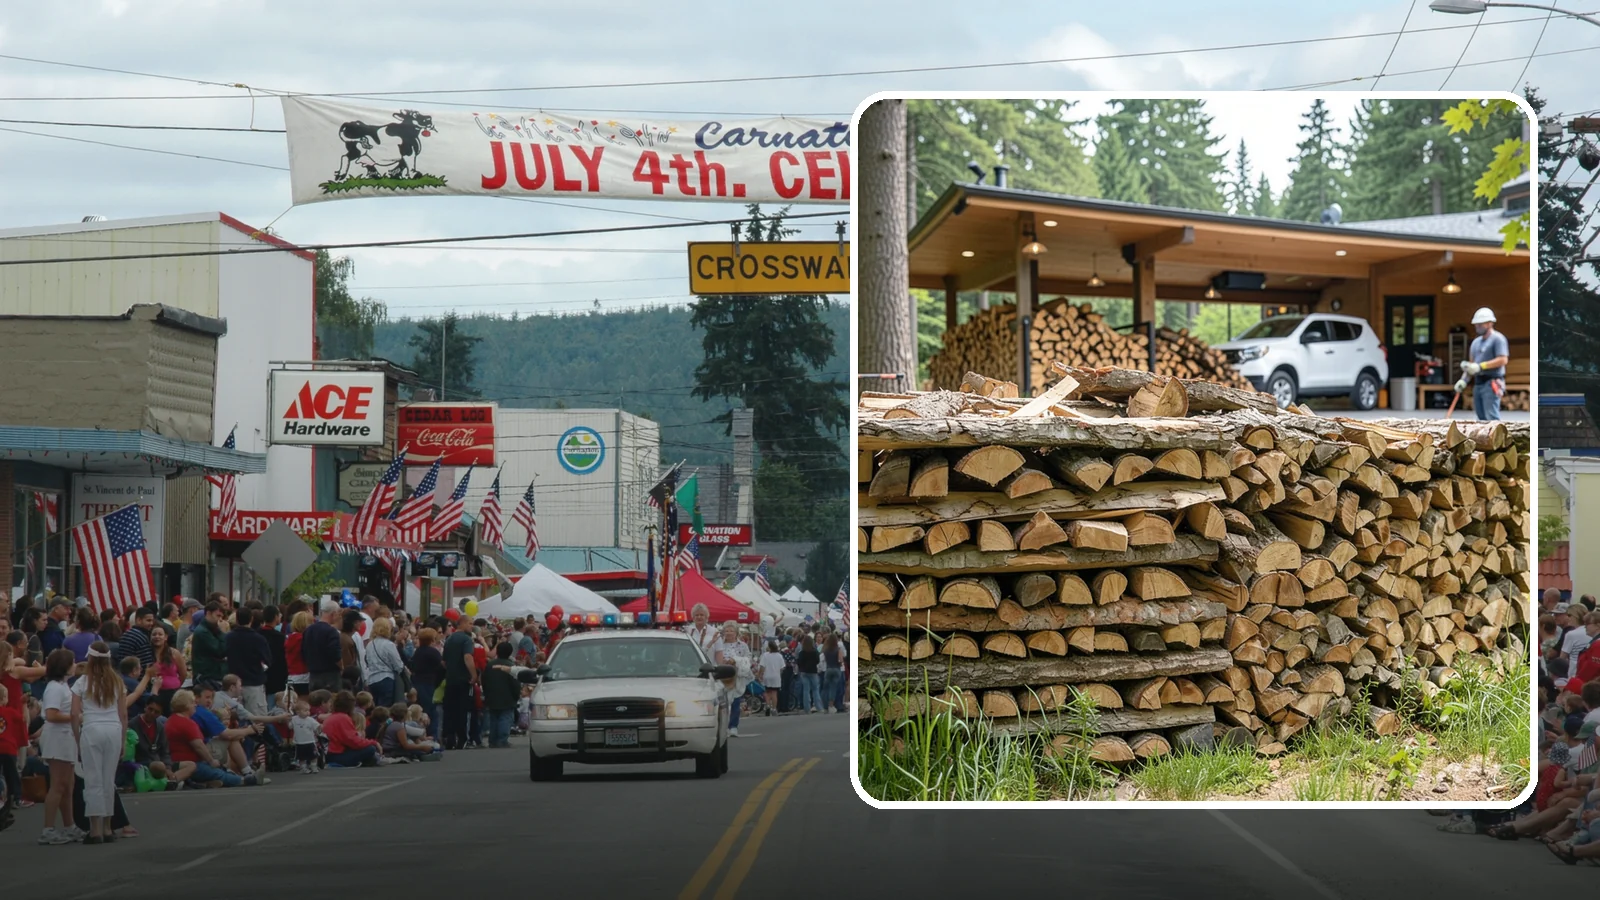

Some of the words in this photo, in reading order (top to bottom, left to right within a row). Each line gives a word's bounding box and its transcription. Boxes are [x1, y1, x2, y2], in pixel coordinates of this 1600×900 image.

[481, 141, 605, 192] JULY
[632, 150, 747, 198] 4th.
[696, 254, 850, 280] CROSSWA
[283, 380, 374, 420] ACE
[405, 409, 453, 422] CEDAR
[283, 421, 371, 437] Hardware
[416, 428, 477, 447] Coca-Cola
[83, 485, 94, 494] St.
[95, 485, 124, 495] Vincent
[126, 486, 136, 495] de
[137, 486, 155, 495] Paul
[688, 526, 741, 535] CRNATION
[699, 535, 730, 543] GLASS
